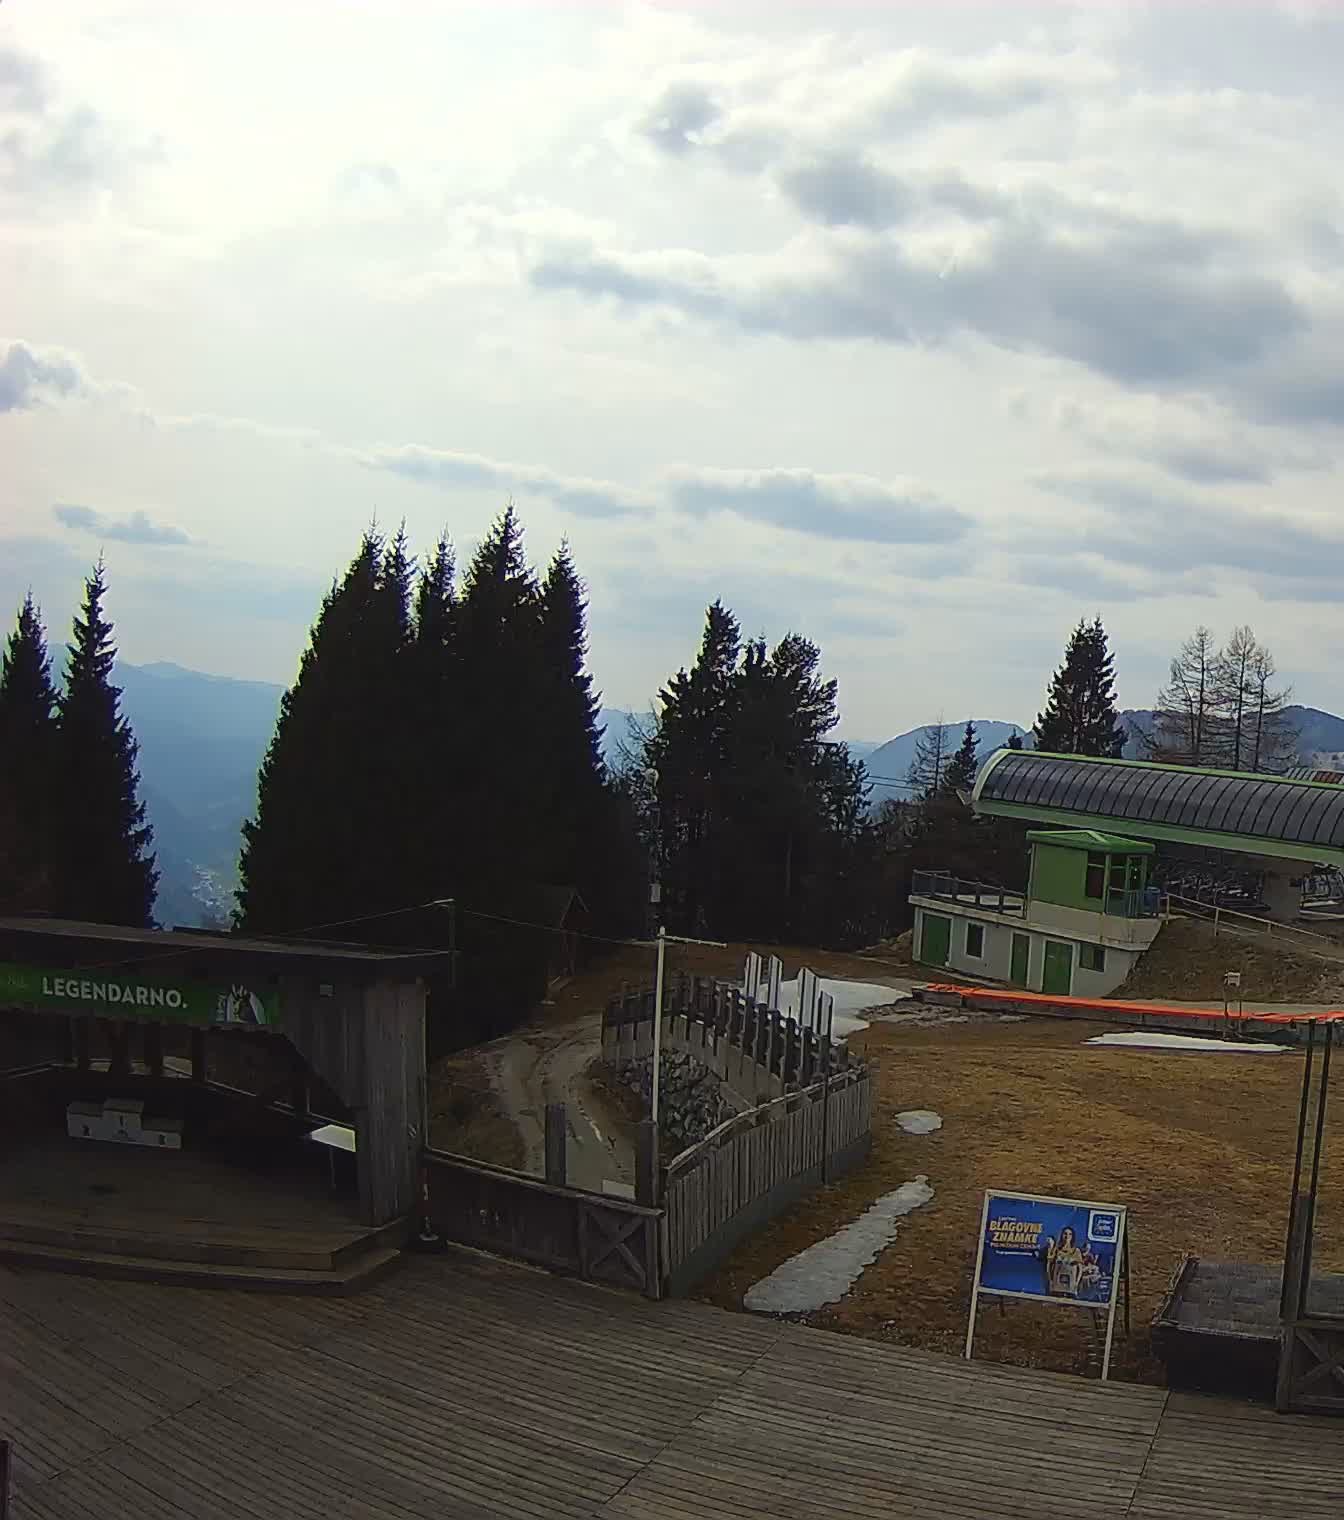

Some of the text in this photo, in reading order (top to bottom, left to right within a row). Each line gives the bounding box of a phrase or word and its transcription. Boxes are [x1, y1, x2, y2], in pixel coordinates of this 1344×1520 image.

[41, 976, 189, 1009] LEGENDARNO.
[989, 1220, 1043, 1233] BLAGOVNE
[992, 1231, 1039, 1244] ZNAMKE
